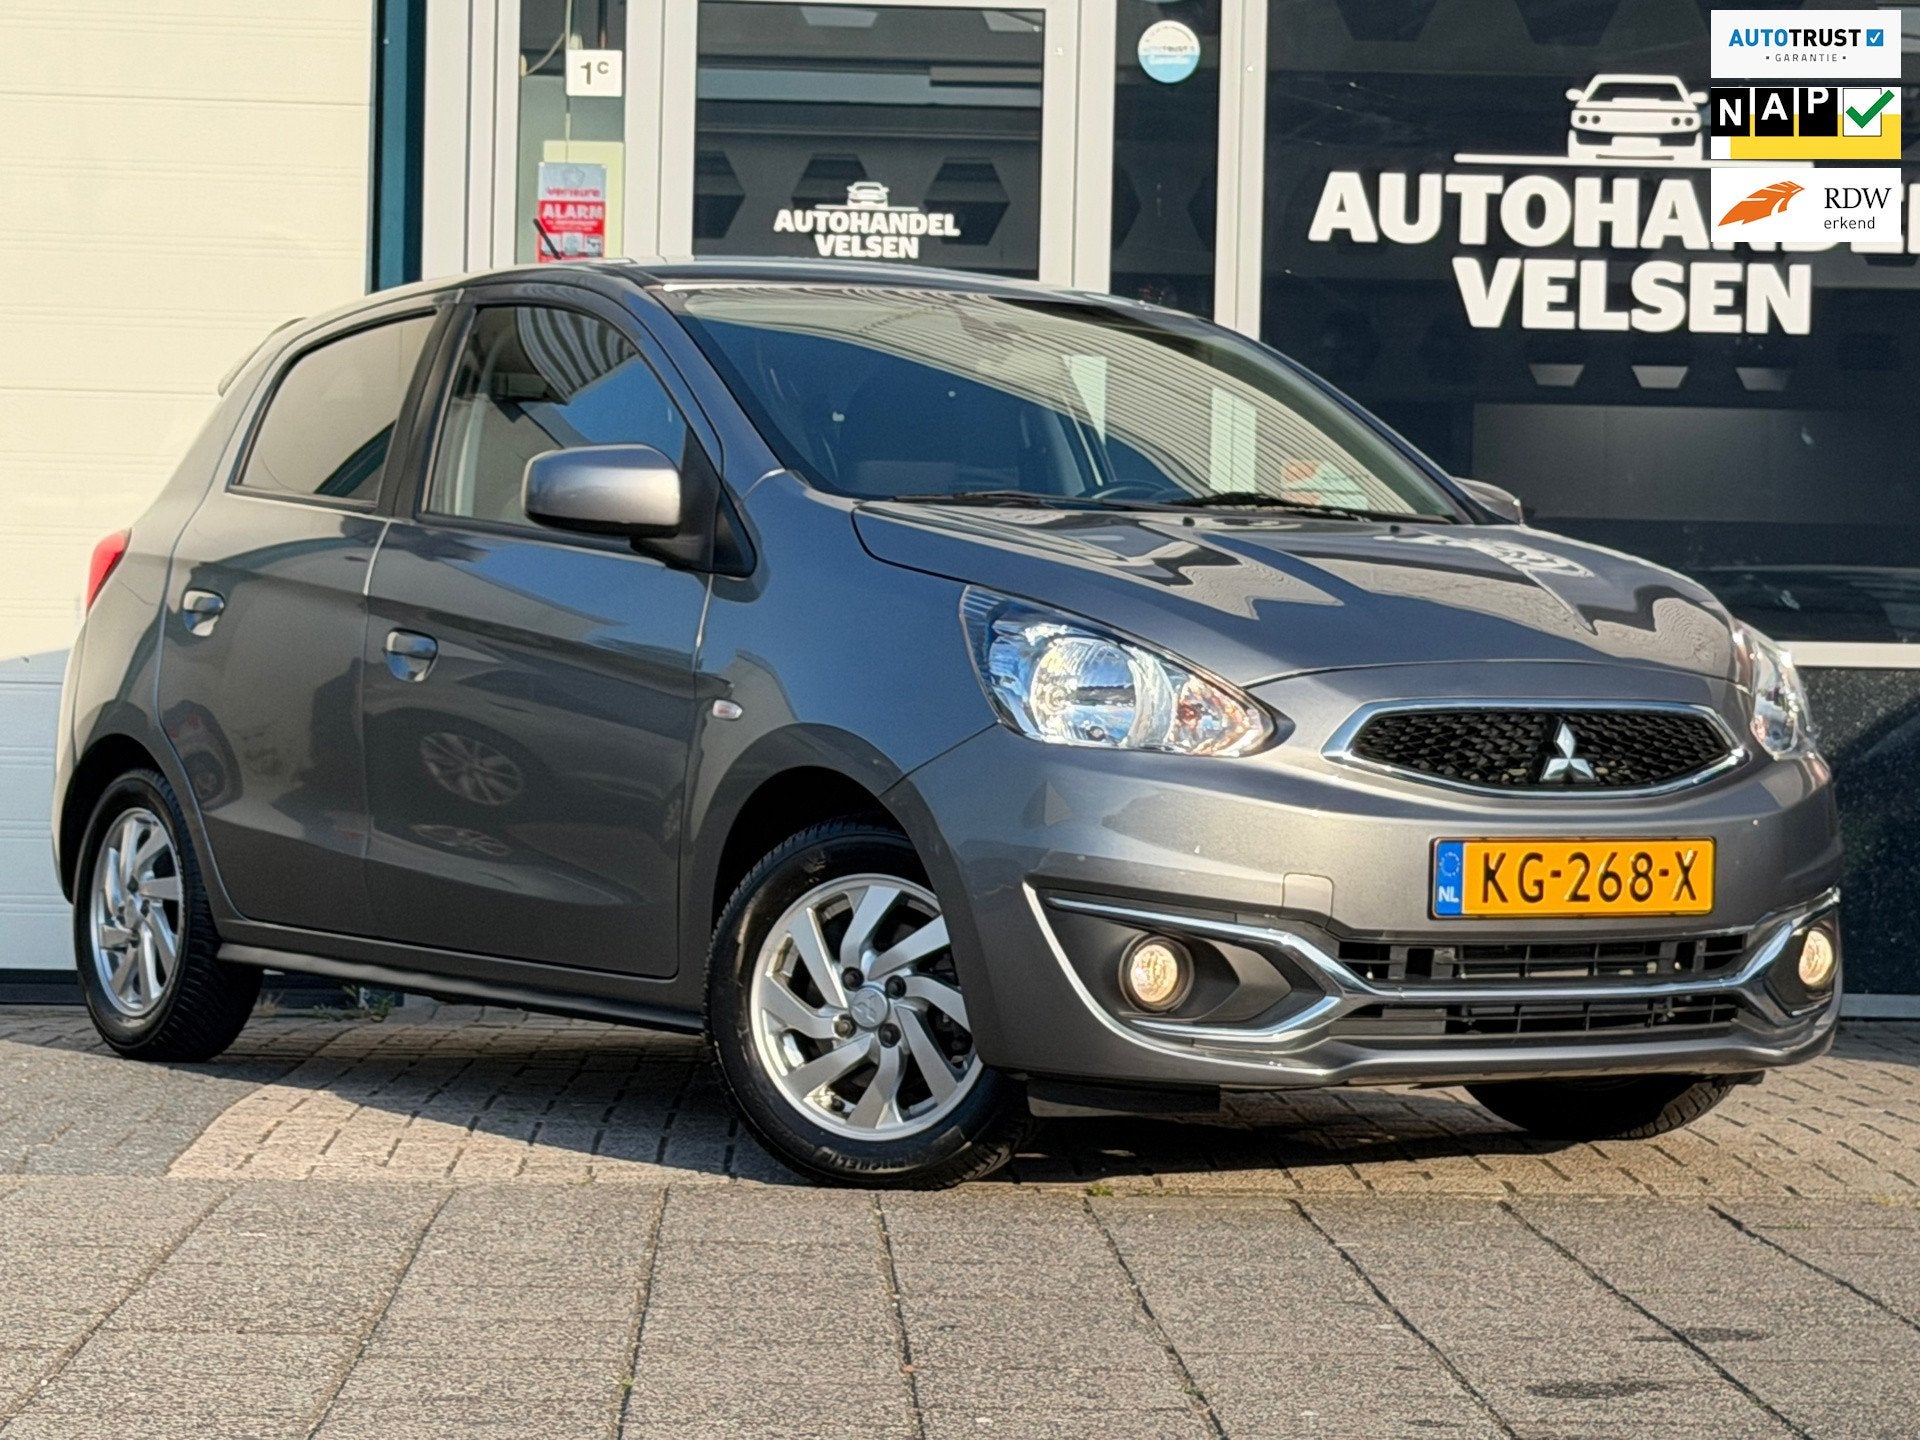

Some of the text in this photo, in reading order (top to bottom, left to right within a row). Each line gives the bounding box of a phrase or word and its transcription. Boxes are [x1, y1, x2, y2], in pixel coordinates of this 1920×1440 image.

[542, 203, 603, 220] ALARM
[773, 209, 961, 237] AUTOHANDEL
[1308, 171, 1920, 254] AUTOHA
[814, 233, 919, 259] VELSEN
[1451, 256, 1812, 335] VELSEN
[1482, 849, 1698, 904] KG-268-X
[1438, 886, 1459, 903] NL
